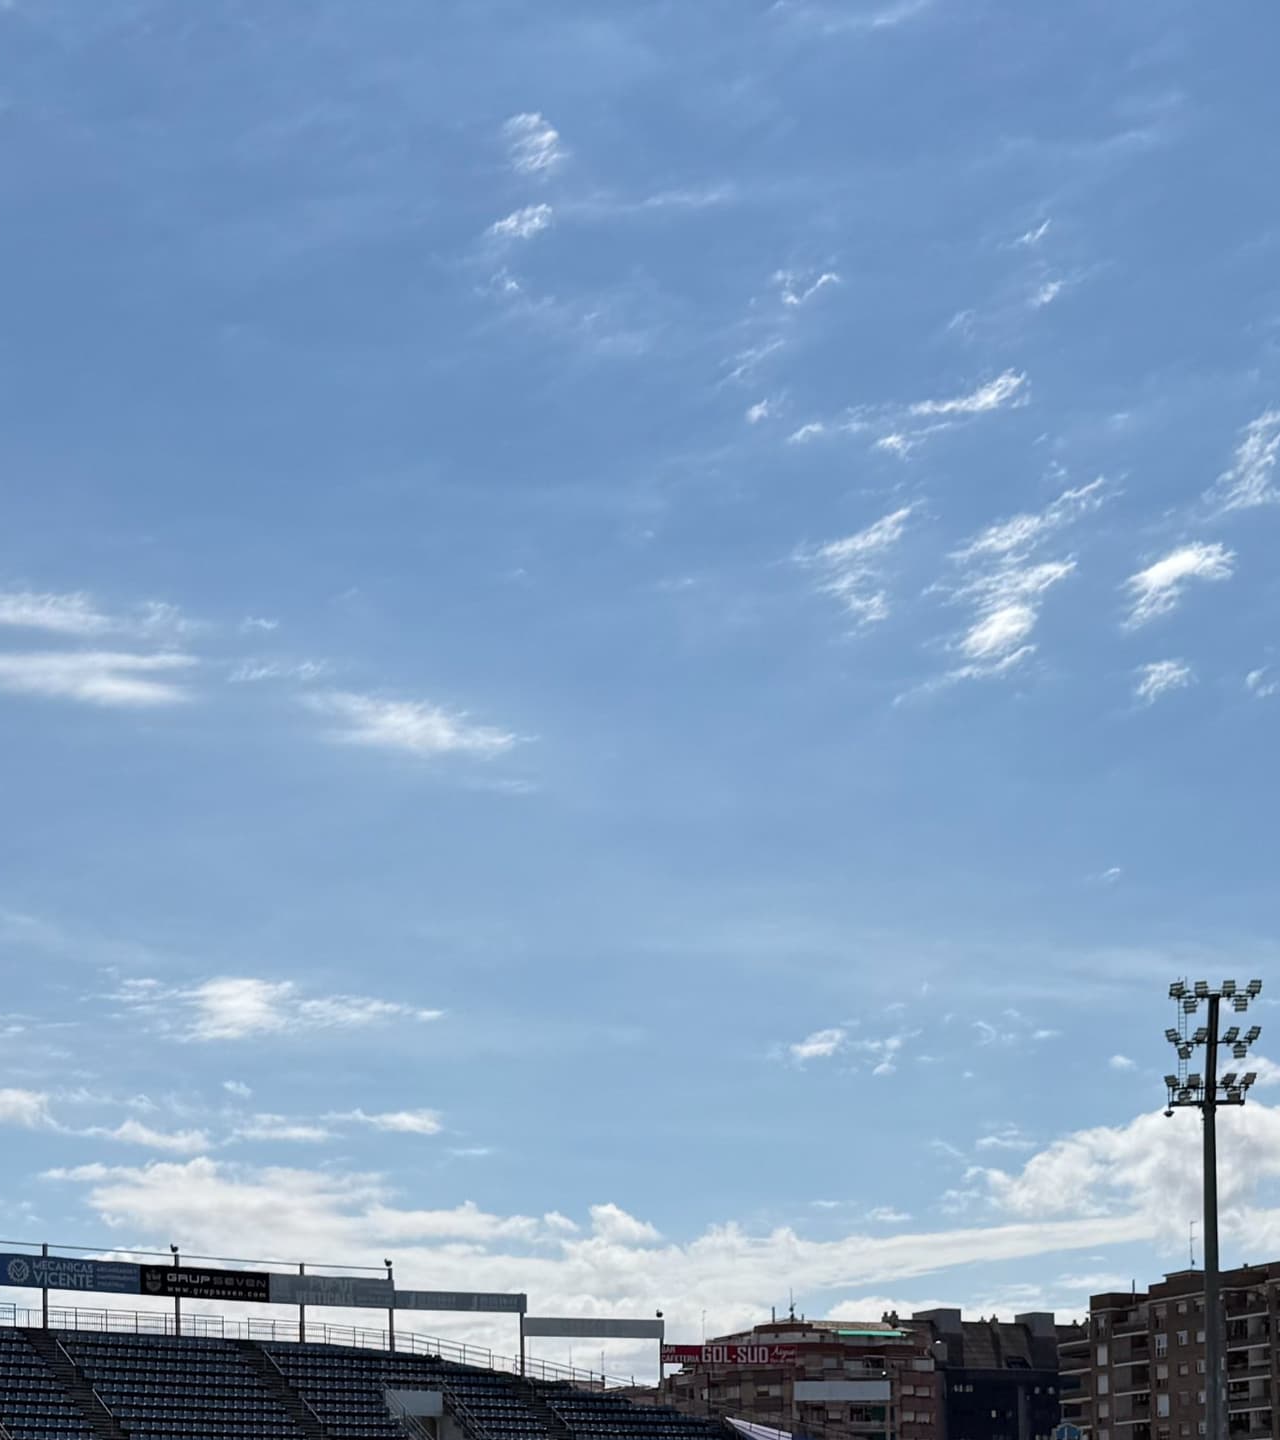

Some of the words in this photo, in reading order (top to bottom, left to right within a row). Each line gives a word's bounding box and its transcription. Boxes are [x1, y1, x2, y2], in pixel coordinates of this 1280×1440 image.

[32, 1271, 94, 1288] VICENTE
[167, 1273, 210, 1284] GRUP
[212, 1276, 266, 1288] SEVEN
